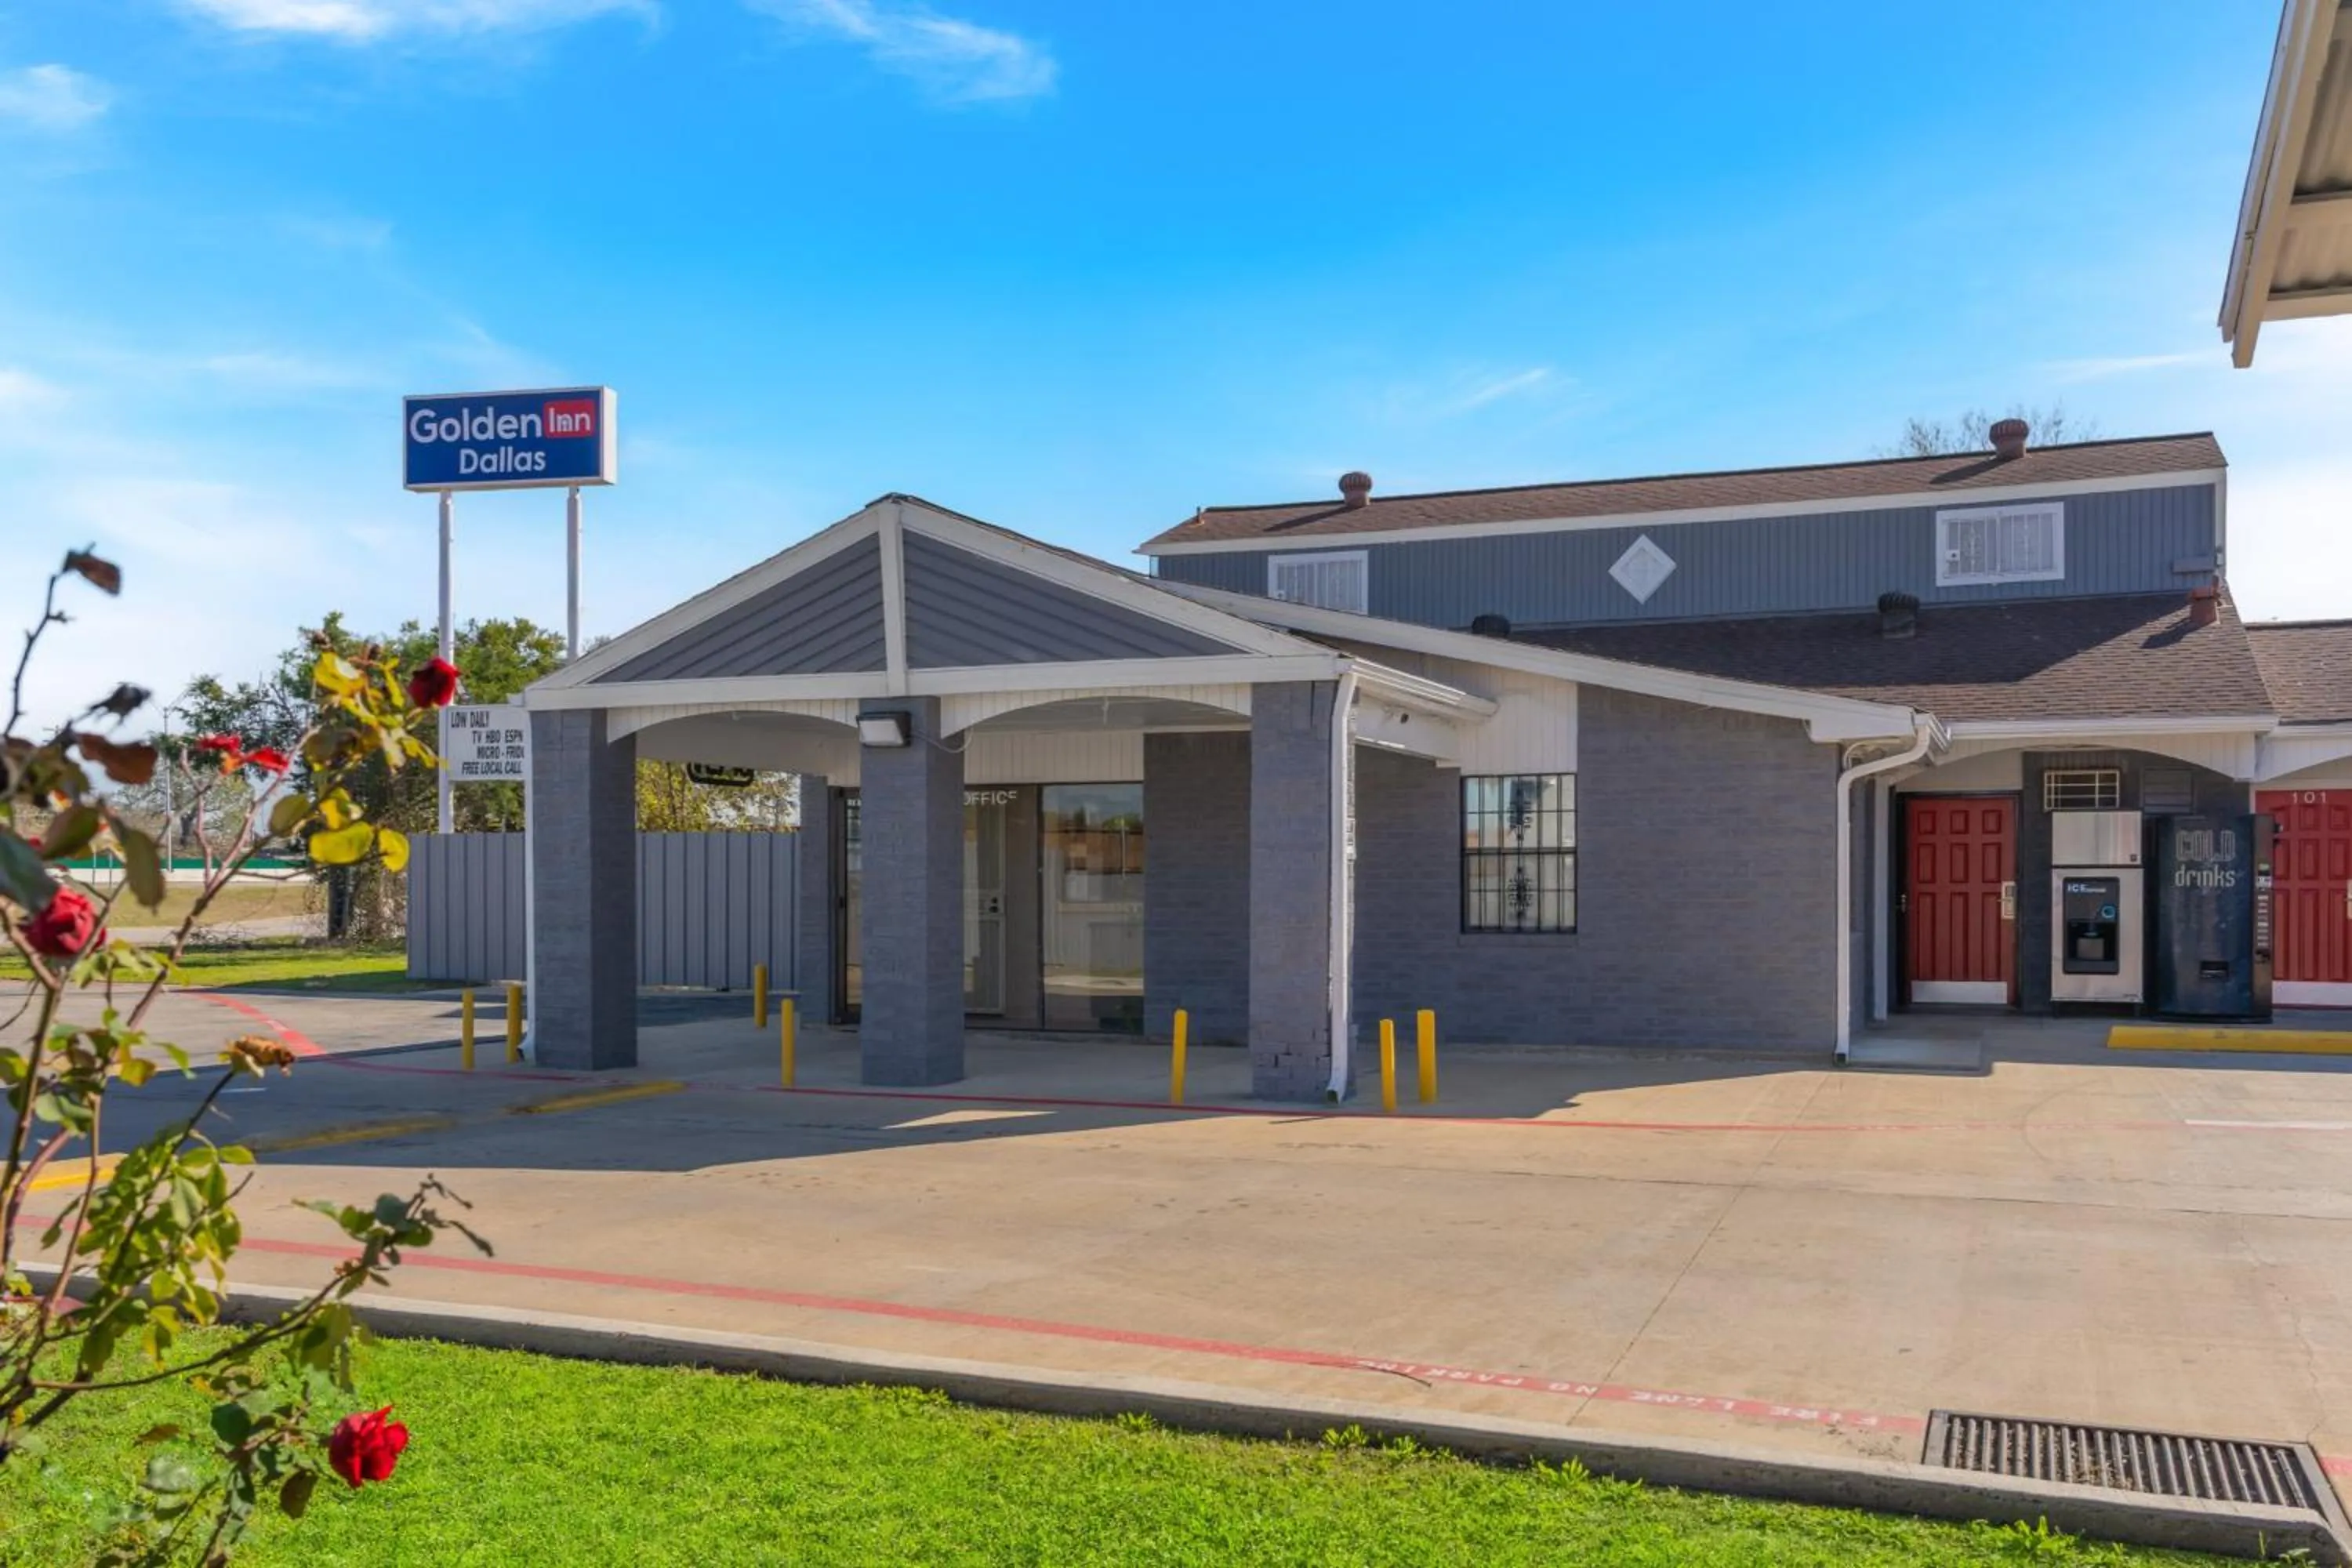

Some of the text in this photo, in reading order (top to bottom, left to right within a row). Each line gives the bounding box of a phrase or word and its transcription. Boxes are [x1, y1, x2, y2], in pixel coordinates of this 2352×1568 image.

[410, 406, 591, 443] Golden Inn
[459, 446, 546, 474] Dallas
[451, 711, 467, 728] LOW
[472, 729, 524, 744] TV HBO ESPN
[462, 761, 480, 775] FREE
[481, 761, 503, 775] LOCAL
[2292, 790, 2326, 804] 101
[2176, 829, 2236, 862] COLD
[2175, 863, 2236, 887] drinks
[1548, 1382, 1598, 1396] NO
